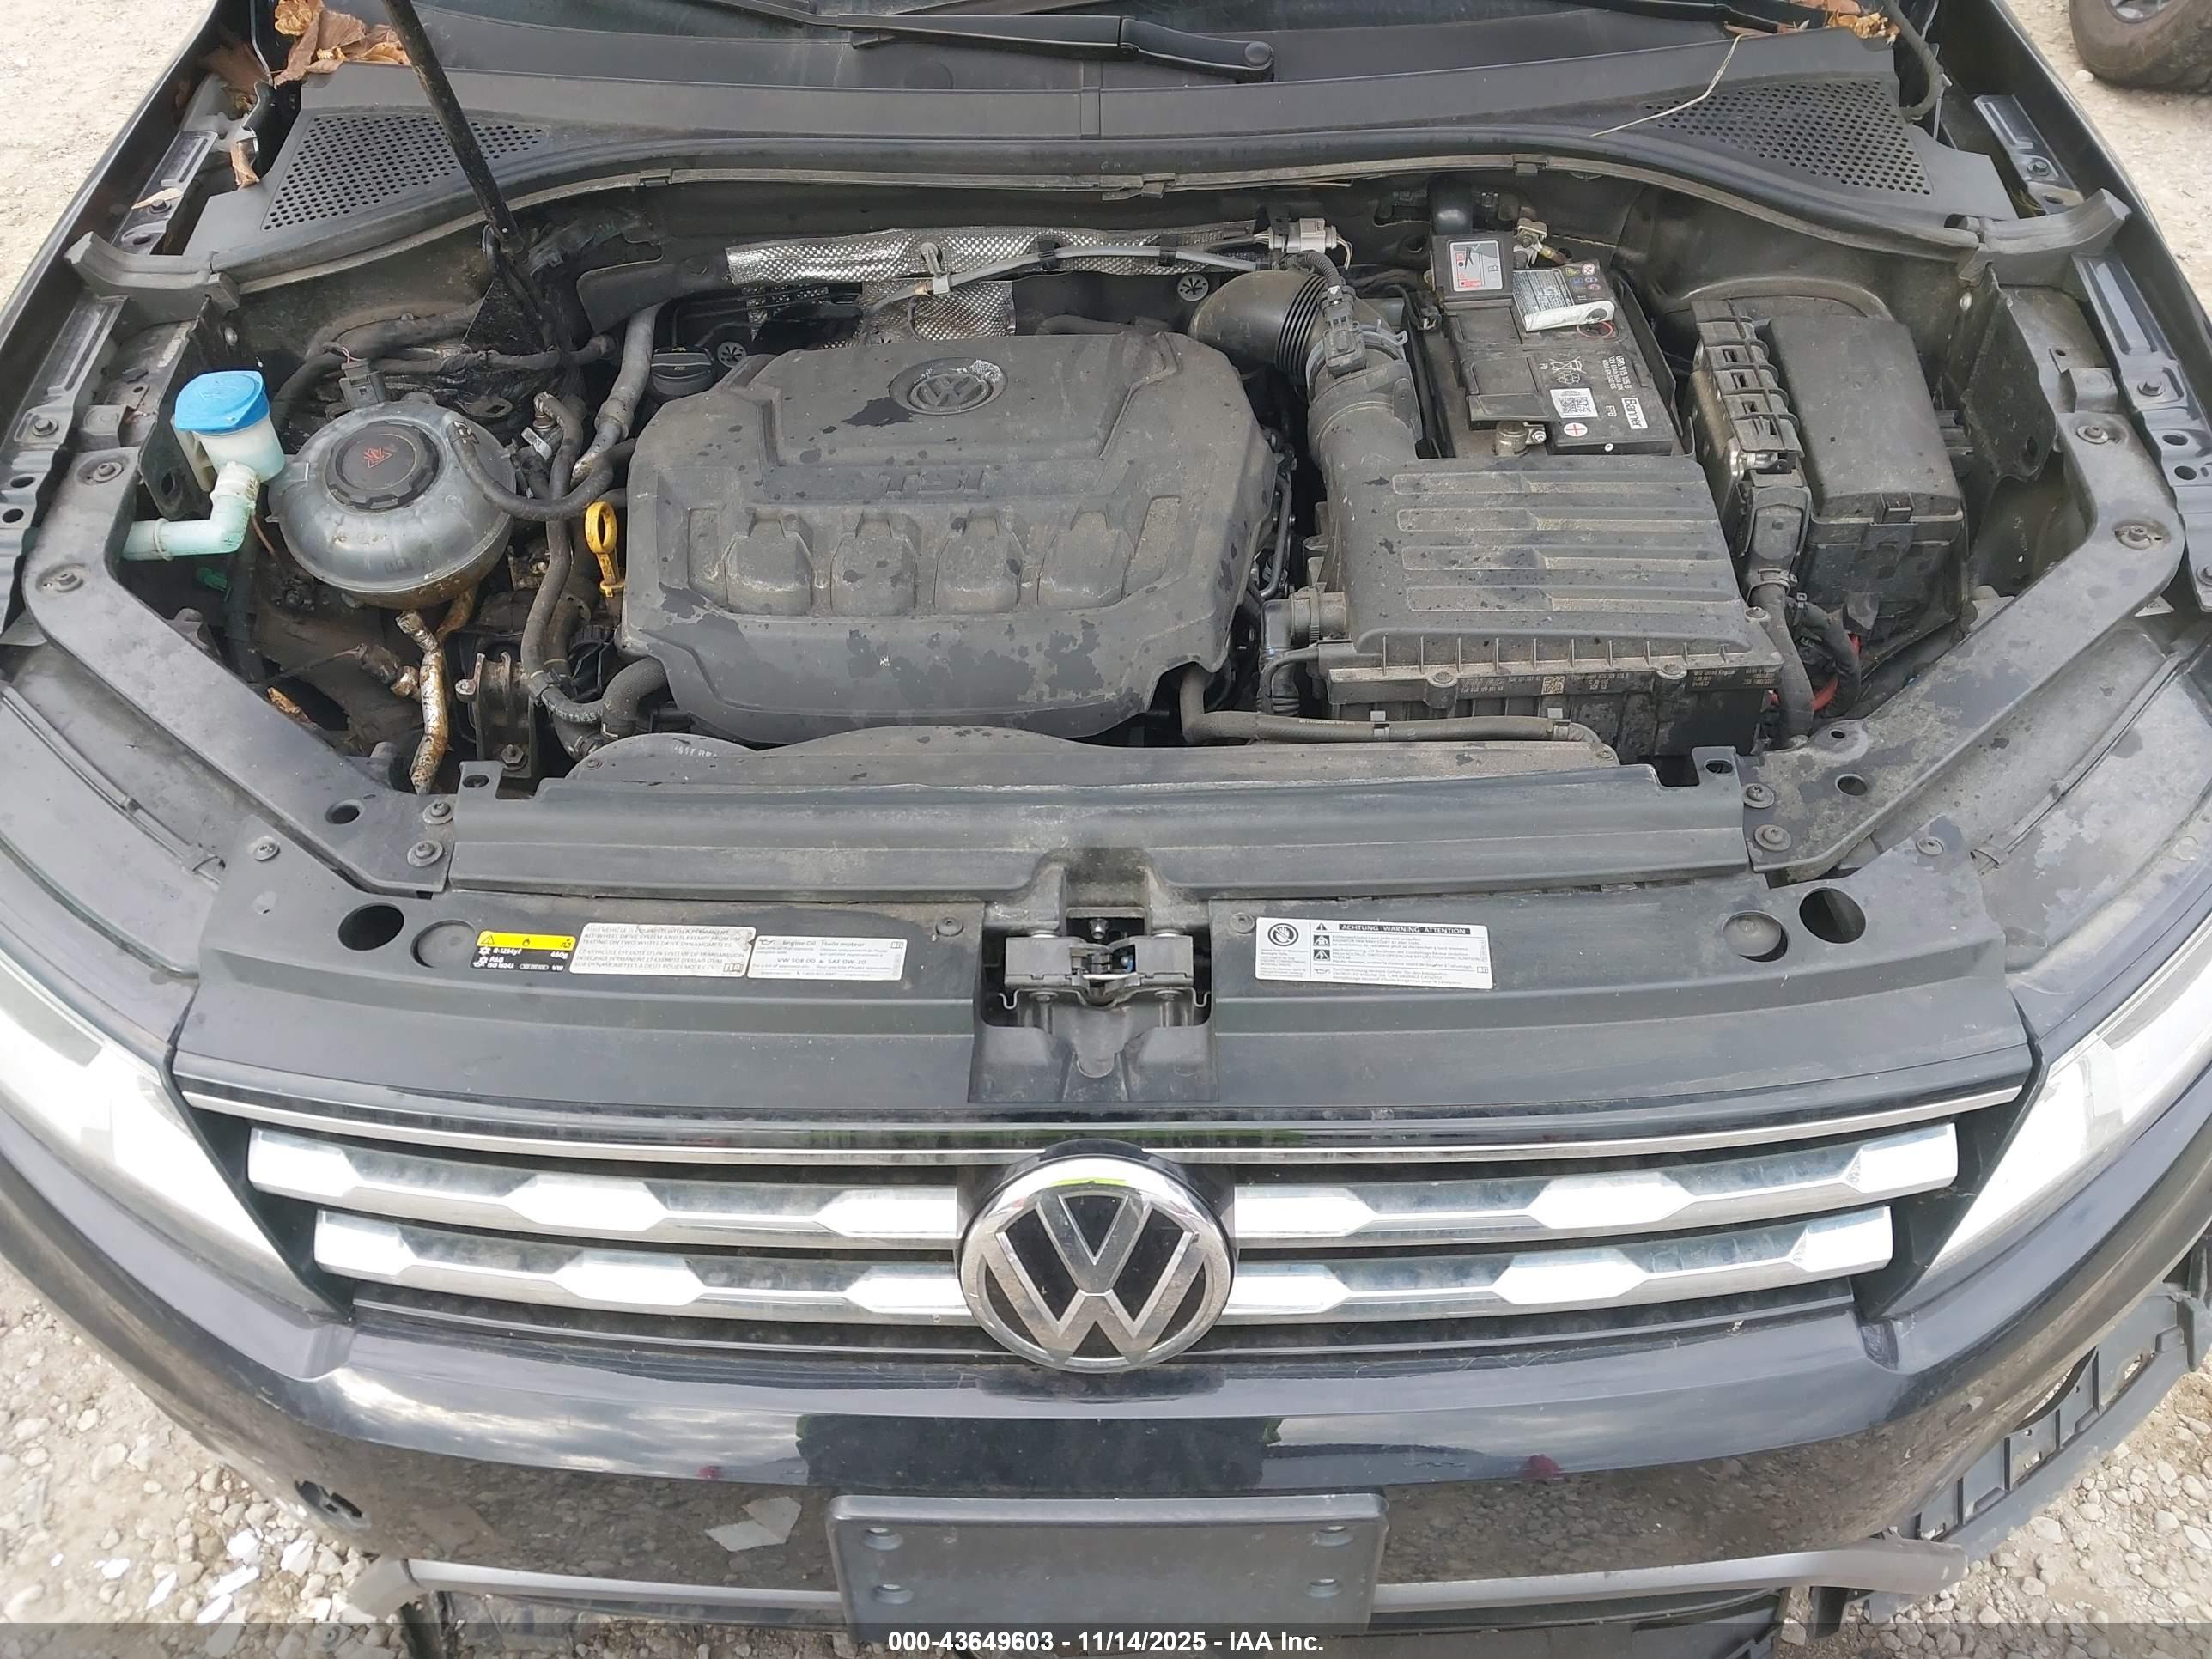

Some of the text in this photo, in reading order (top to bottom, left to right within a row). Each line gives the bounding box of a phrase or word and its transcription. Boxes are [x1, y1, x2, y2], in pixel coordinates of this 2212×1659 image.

[914, 374, 986, 409] VW
[1606, 405, 1617, 417] EFB
[1624, 398, 1642, 428] Banner
[879, 470, 984, 495] TSI
[977, 1178, 1212, 1367] VW
